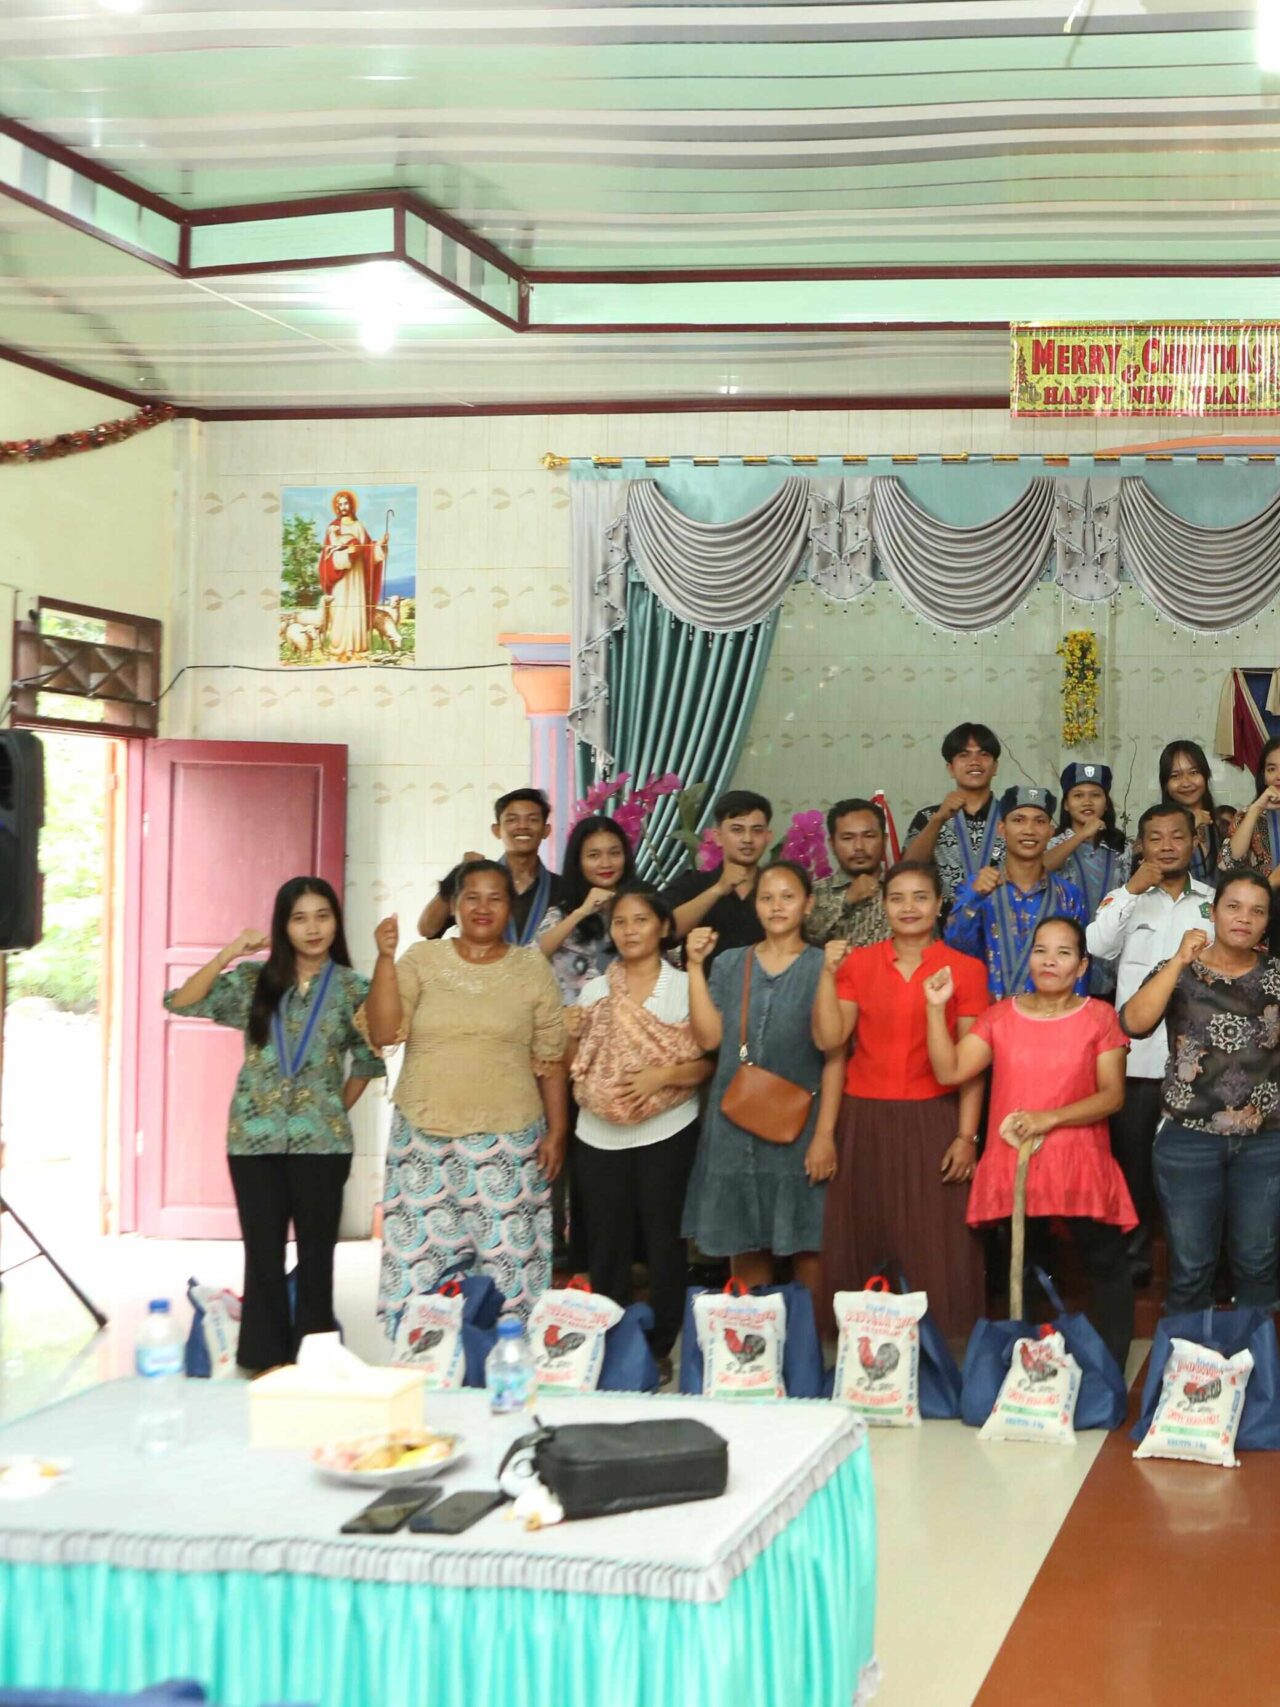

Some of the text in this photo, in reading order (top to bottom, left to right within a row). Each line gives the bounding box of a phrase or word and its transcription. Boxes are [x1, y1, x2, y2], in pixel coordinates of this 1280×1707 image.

[1031, 338, 1262, 383] MERRY & CHRISTMAS
[1043, 386, 1250, 405] HAPPY NEW YEAR
